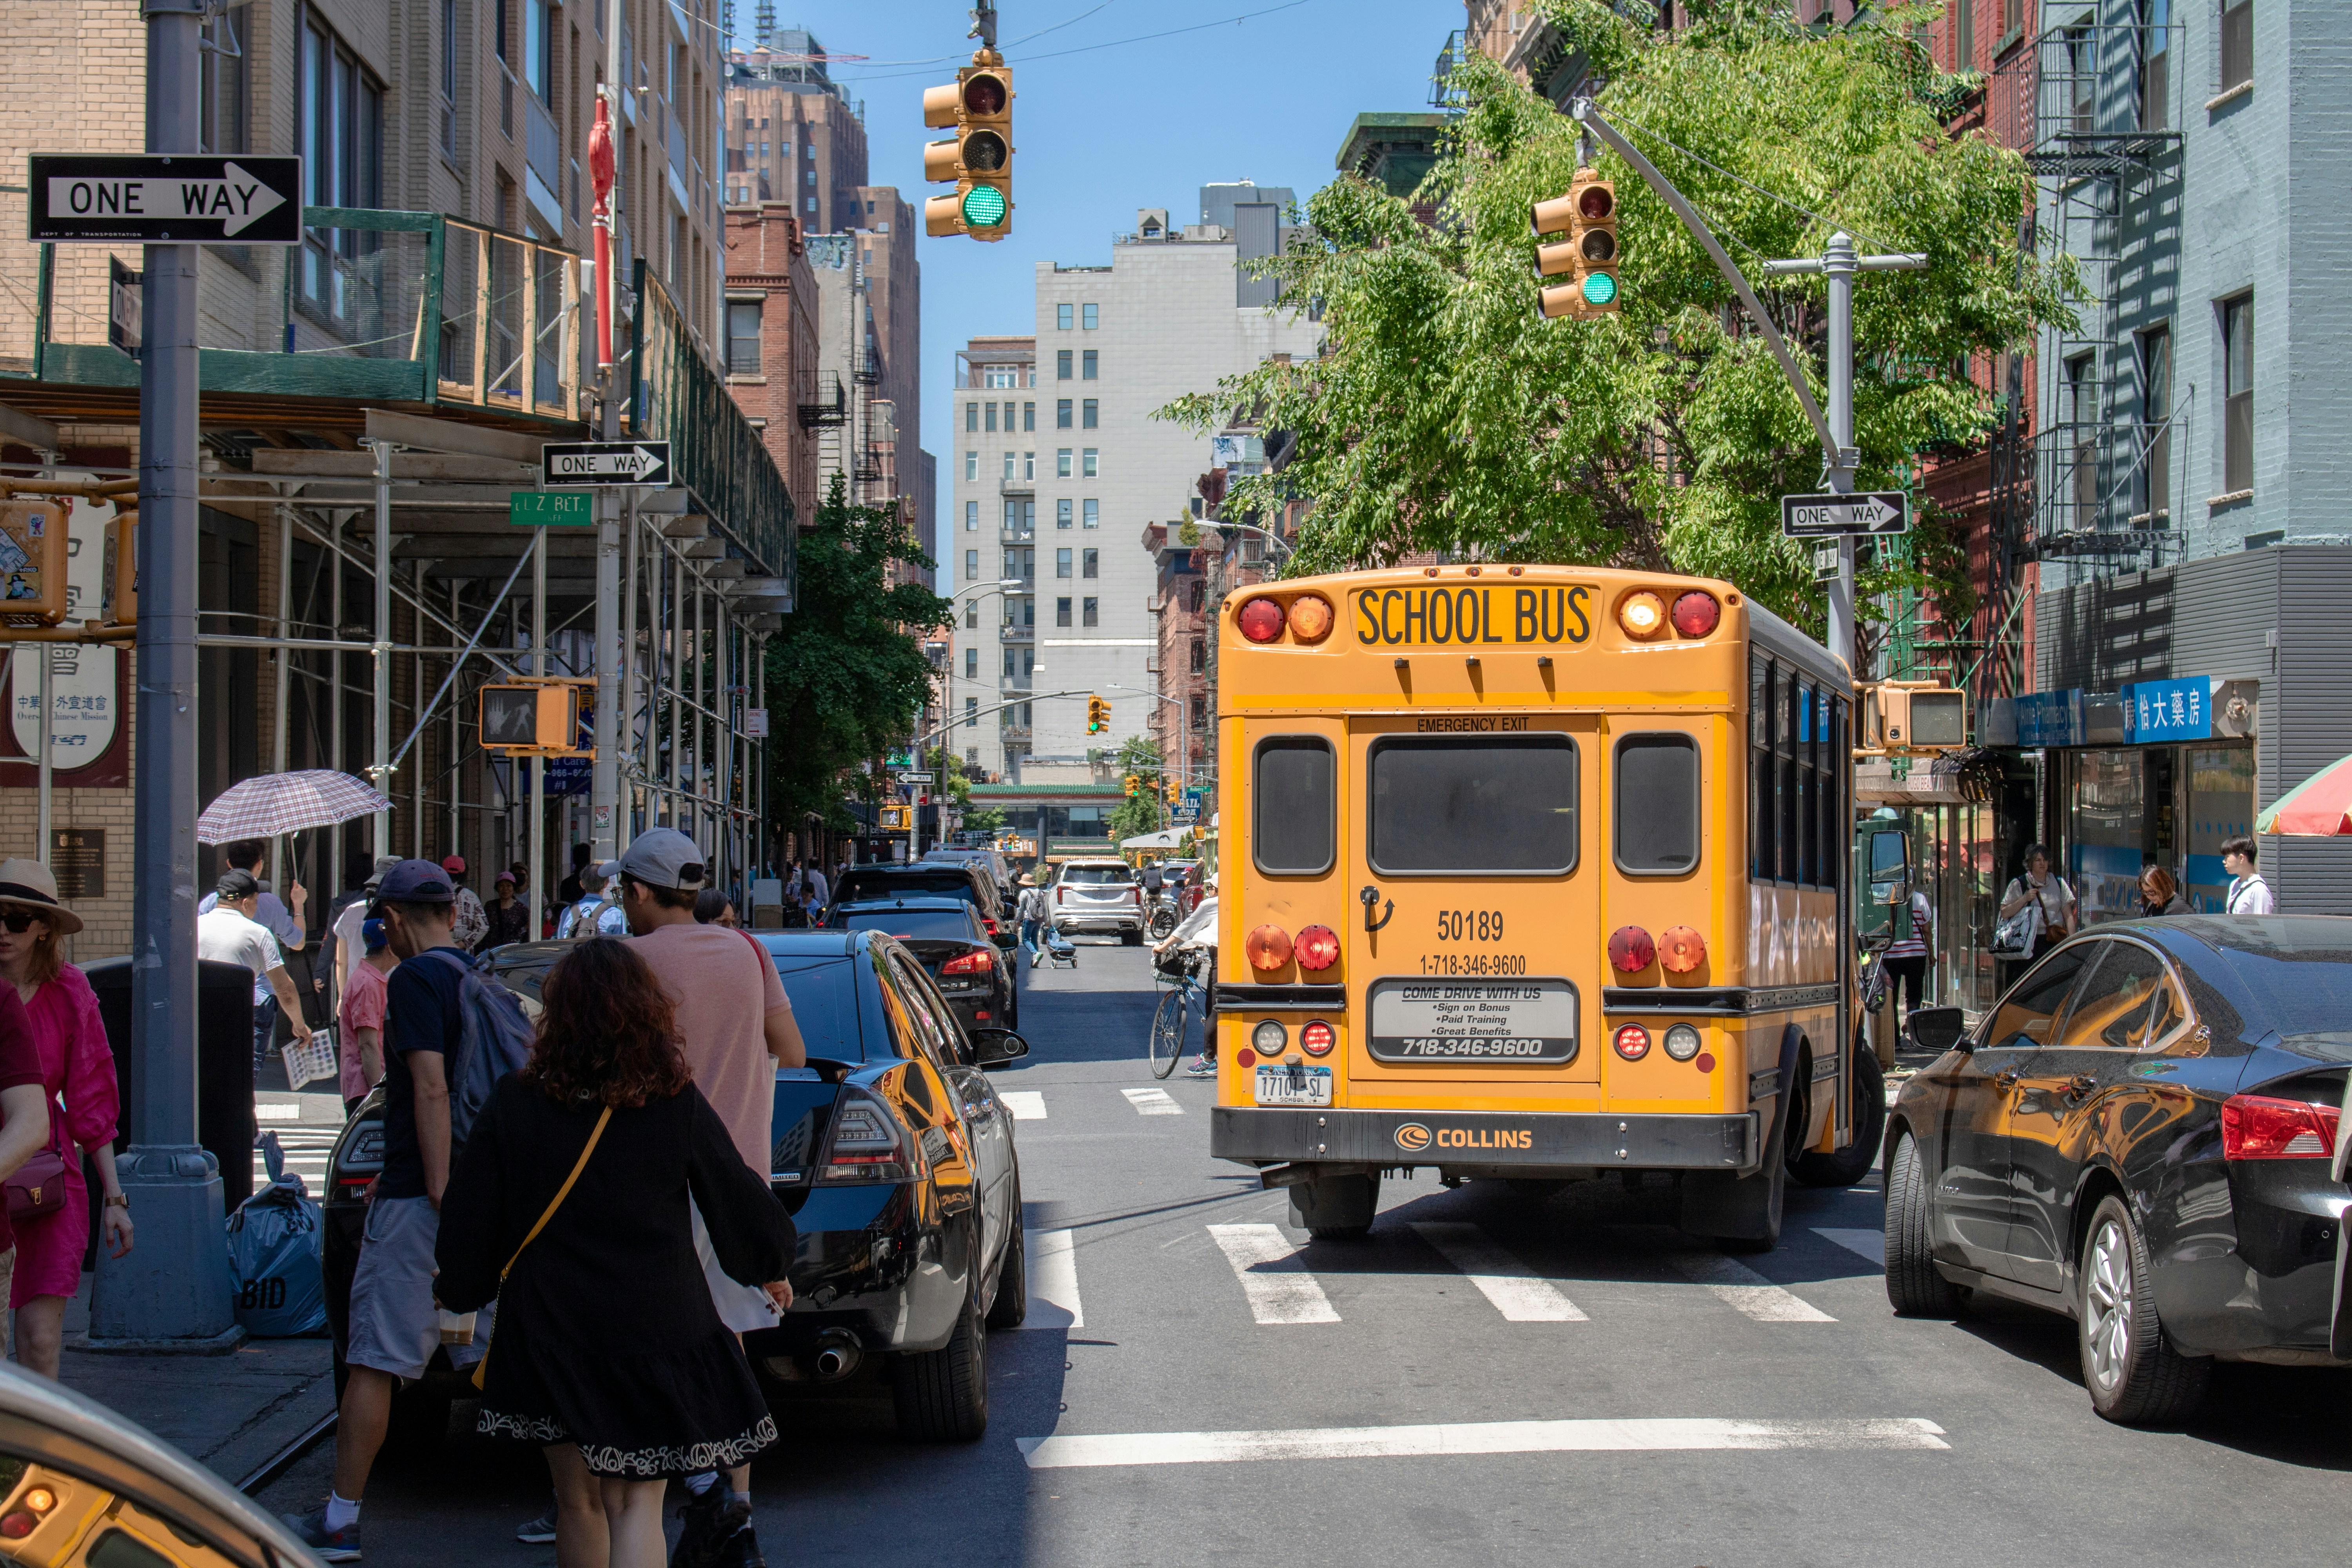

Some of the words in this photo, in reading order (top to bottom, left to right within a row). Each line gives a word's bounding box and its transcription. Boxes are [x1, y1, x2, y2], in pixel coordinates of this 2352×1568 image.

[70, 182, 144, 214] ONE
[182, 184, 260, 215] WAY
[562, 457, 597, 472] ONE
[614, 456, 651, 472] WAY
[1797, 508, 1829, 523] ONE
[1851, 506, 1885, 521] WAY
[1827, 550, 1836, 567] WAY
[1358, 588, 1502, 645] SCHOOL
[1515, 587, 1590, 643] BUS
[18, 695, 107, 710] 中華外宣道會
[2125, 688, 2200, 731] 康怡大藥房
[81, 711, 108, 721] Mission
[2037, 701, 2068, 730] Pharmacy
[1417, 717, 1496, 732] EMERGENCY
[1502, 717, 1529, 731] EXIT
[1907, 777, 1920, 790] HUGO
[1437, 910, 1503, 941] 50189
[1420, 955, 1526, 975] 1-718-346-9600
[1403, 987, 1440, 999] COME
[1444, 987, 1482, 999] DRIVE
[1486, 987, 1519, 999] WITH
[1523, 987, 1541, 999] US
[1479, 1003, 1510, 1011] Bonus
[1467, 1015, 1507, 1025] Training
[1469, 1027, 1512, 1035] Benefits
[1403, 1039, 1543, 1055] 718-346-9600
[1294, 1067, 1313, 1076] YORK
[1262, 1076, 1297, 1096] 17101
[1309, 1078, 1324, 1097] SL
[1437, 1129, 1532, 1148] COLLINS
[240, 1276, 287, 1310] BID
